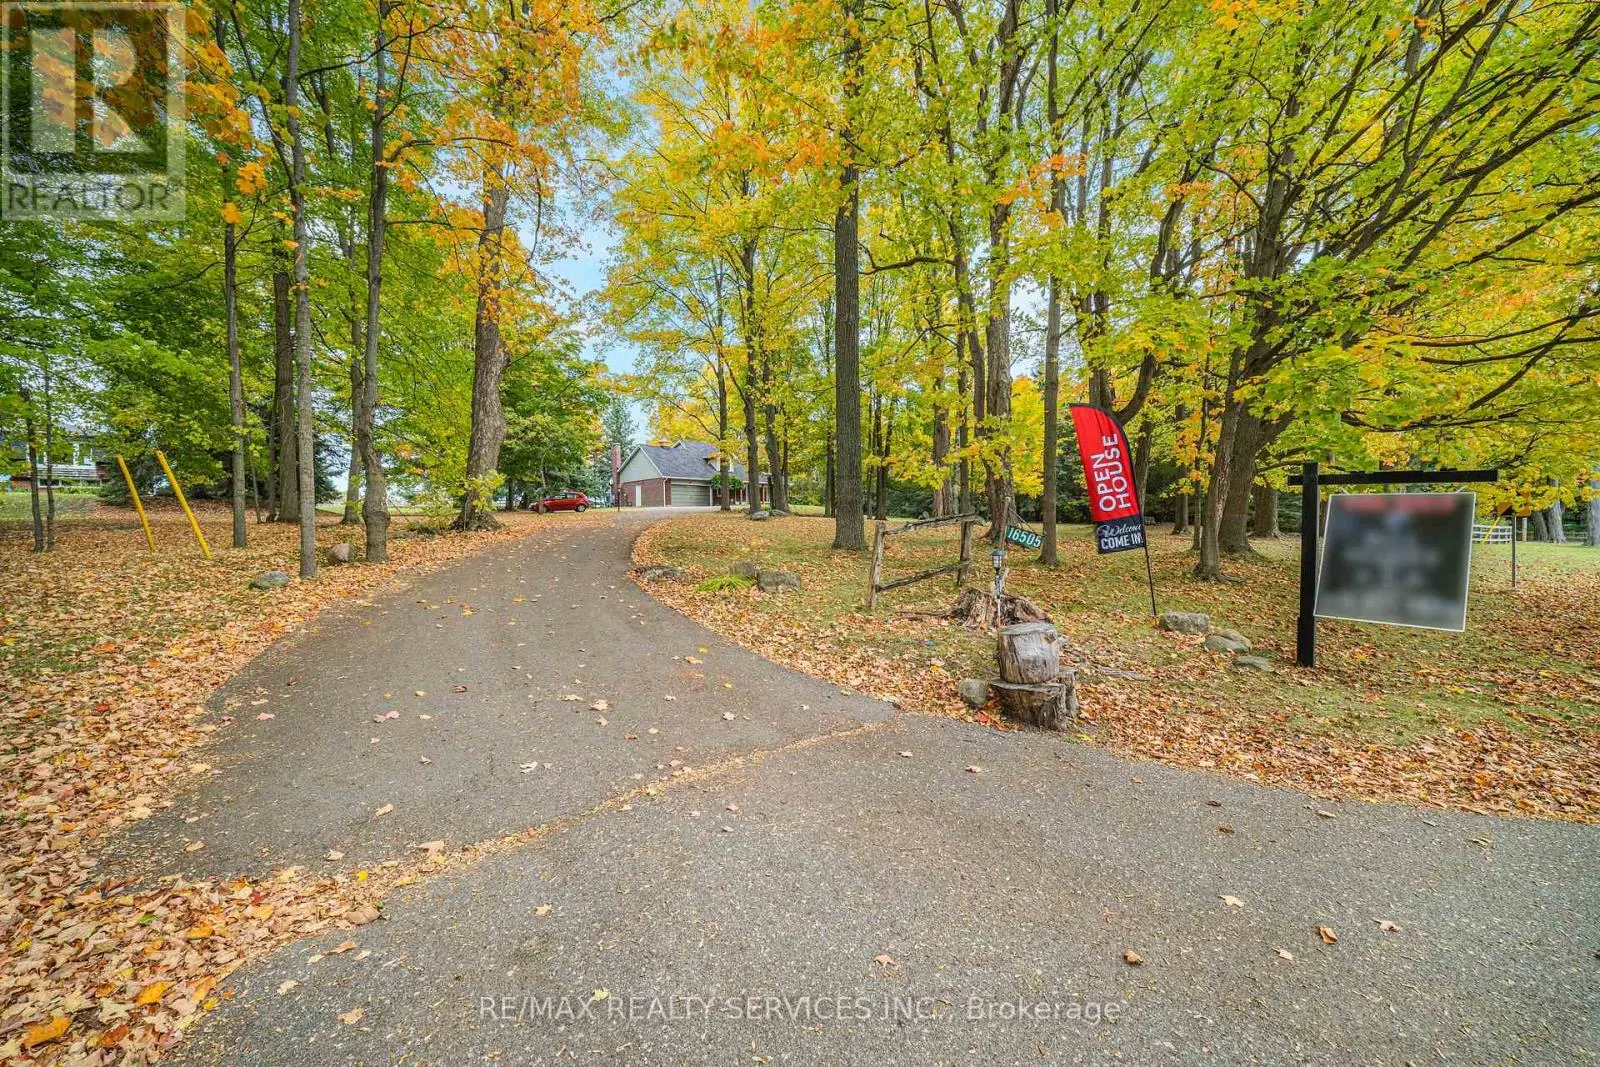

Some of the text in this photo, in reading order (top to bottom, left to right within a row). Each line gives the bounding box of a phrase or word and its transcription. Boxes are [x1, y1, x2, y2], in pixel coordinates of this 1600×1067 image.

[1091, 453, 1117, 512] OPEN
[1102, 433, 1131, 509] HOUSE
[1007, 527, 1042, 548] 16505
[1100, 534, 1130, 549] COME
